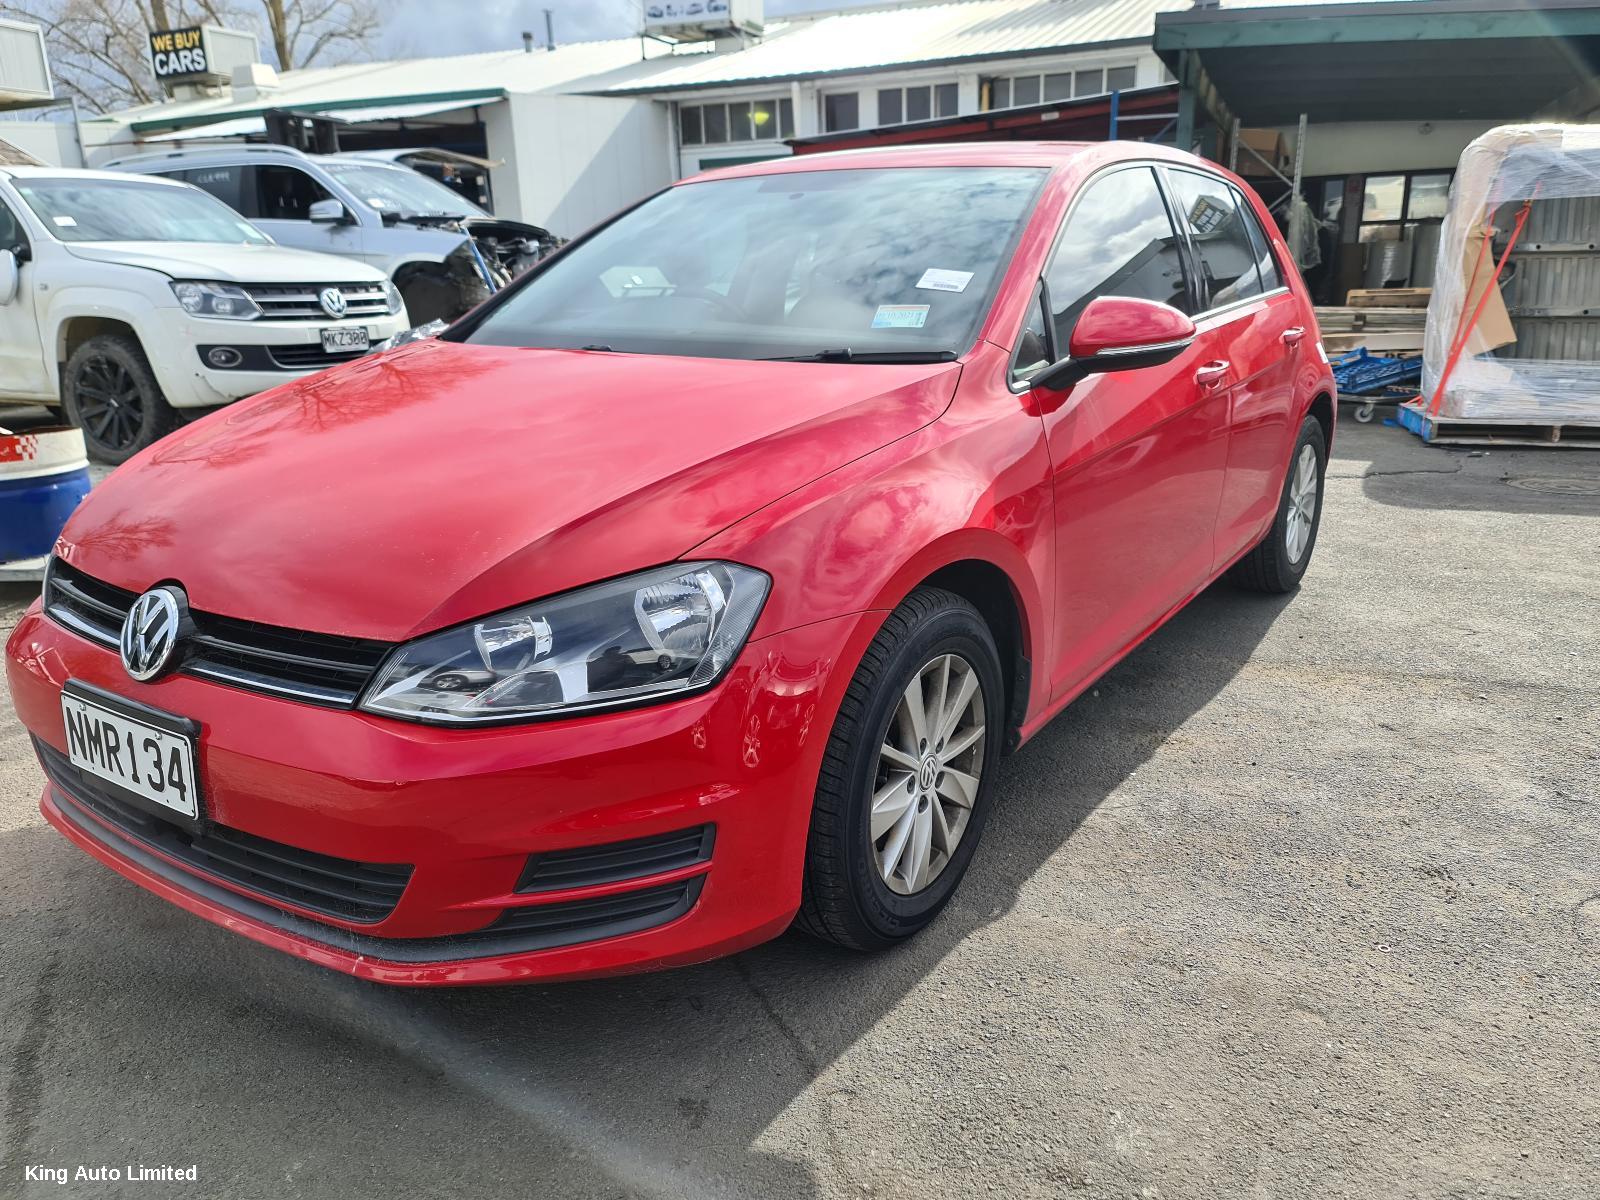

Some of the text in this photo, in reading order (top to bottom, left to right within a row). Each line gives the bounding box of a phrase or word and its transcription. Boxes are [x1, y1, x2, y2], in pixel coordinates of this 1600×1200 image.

[151, 30, 200, 52] WE BUY
[155, 48, 206, 75] CARS
[120, 588, 179, 682] VW
[66, 706, 186, 802] NMR134
